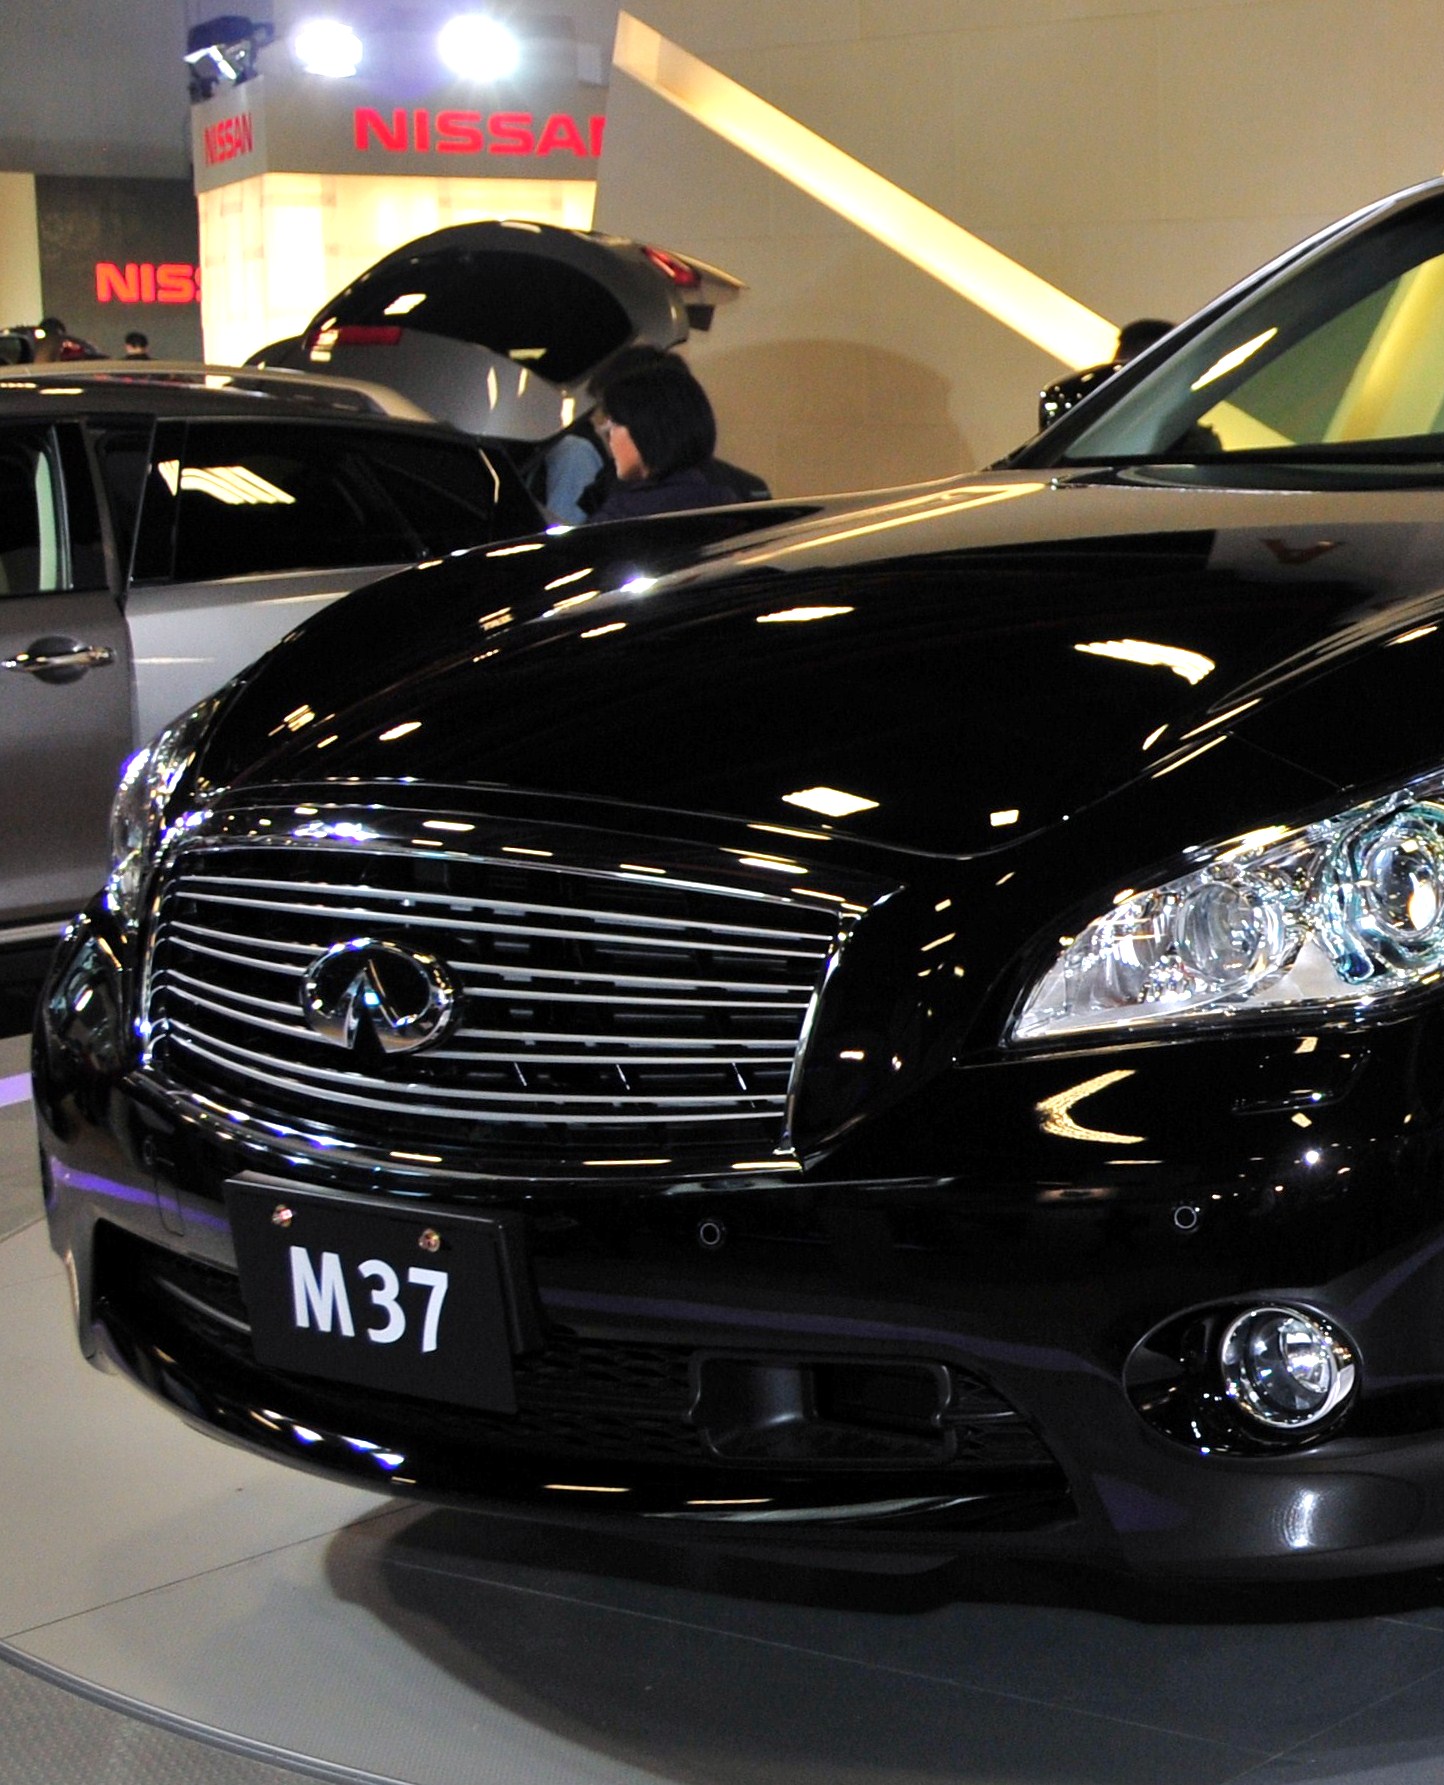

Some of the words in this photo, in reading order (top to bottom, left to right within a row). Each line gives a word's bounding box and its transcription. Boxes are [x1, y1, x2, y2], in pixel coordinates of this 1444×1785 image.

[205, 113, 253, 168] NISSAN
[354, 107, 605, 157] NISSA
[95, 262, 201, 303] NIS
[290, 1246, 448, 1352] M37
